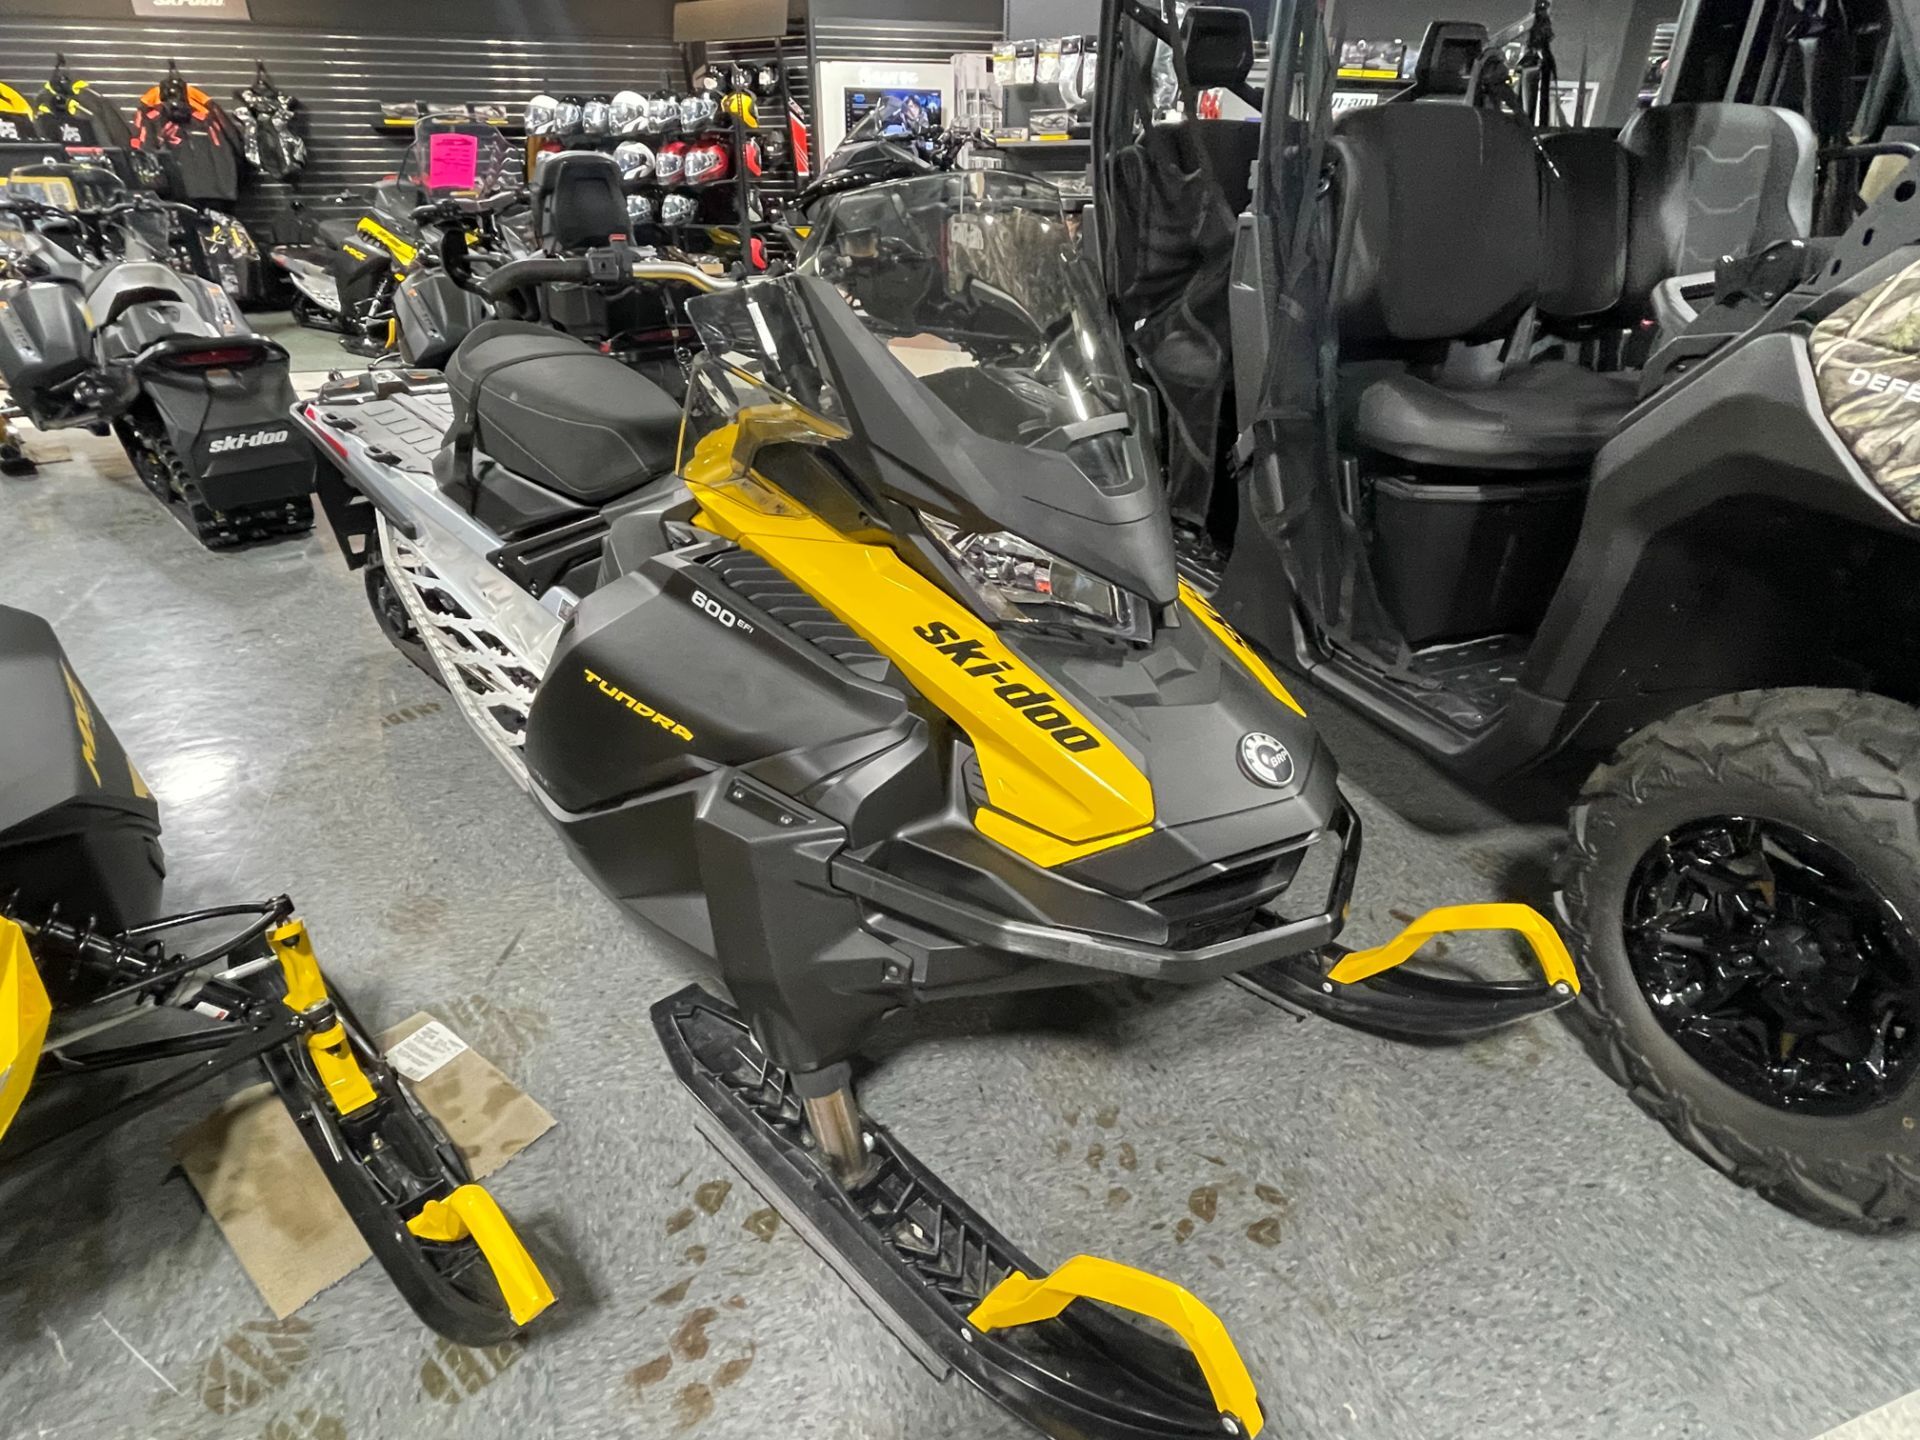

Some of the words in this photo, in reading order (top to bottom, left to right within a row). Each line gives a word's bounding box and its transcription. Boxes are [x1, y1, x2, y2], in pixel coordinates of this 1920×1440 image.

[208, 430, 289, 453] ski-doo
[691, 590, 736, 627] 600
[736, 618, 754, 634] EFI
[584, 668, 694, 741] TUNDRA
[913, 621, 1101, 753] ski-doo
[1270, 750, 1289, 768] BRP
